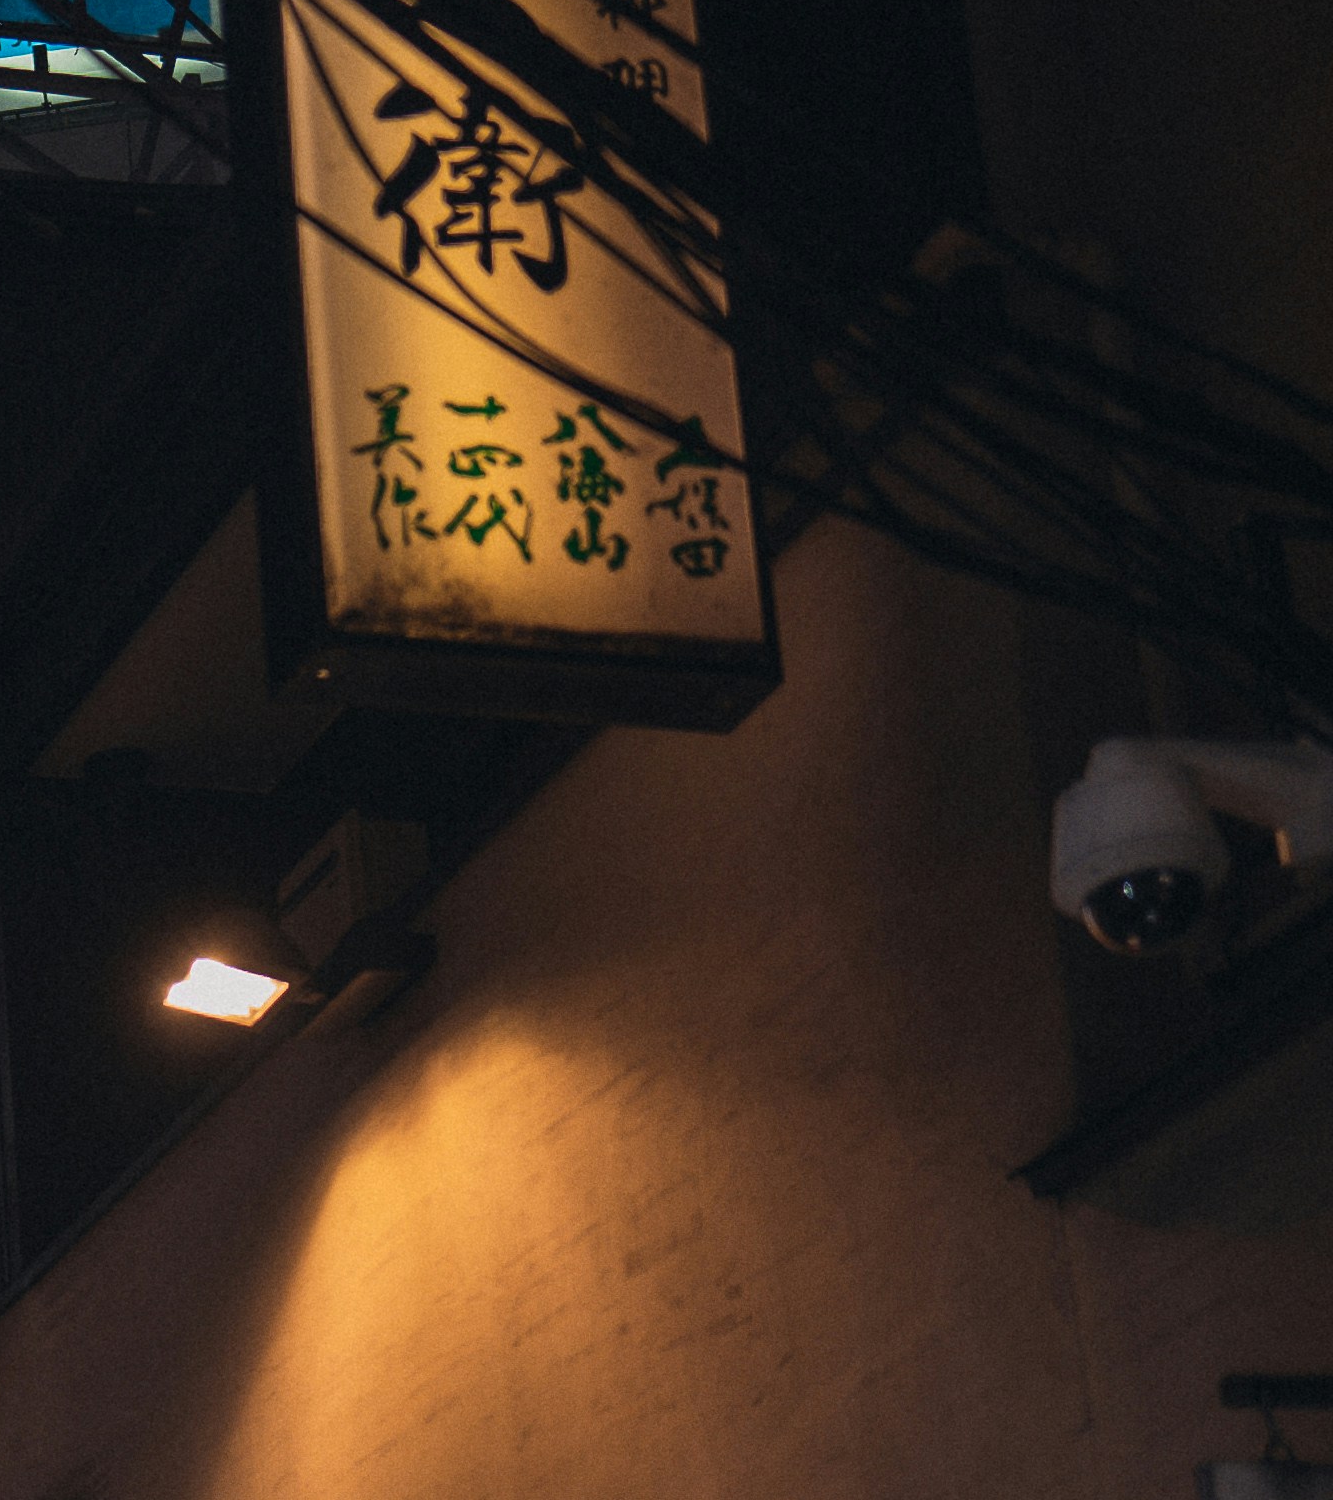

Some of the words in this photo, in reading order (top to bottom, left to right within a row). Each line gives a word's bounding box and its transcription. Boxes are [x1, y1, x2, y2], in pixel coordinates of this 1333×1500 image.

[444, 395, 533, 563] 十四代
[542, 404, 637, 572] 八海山
